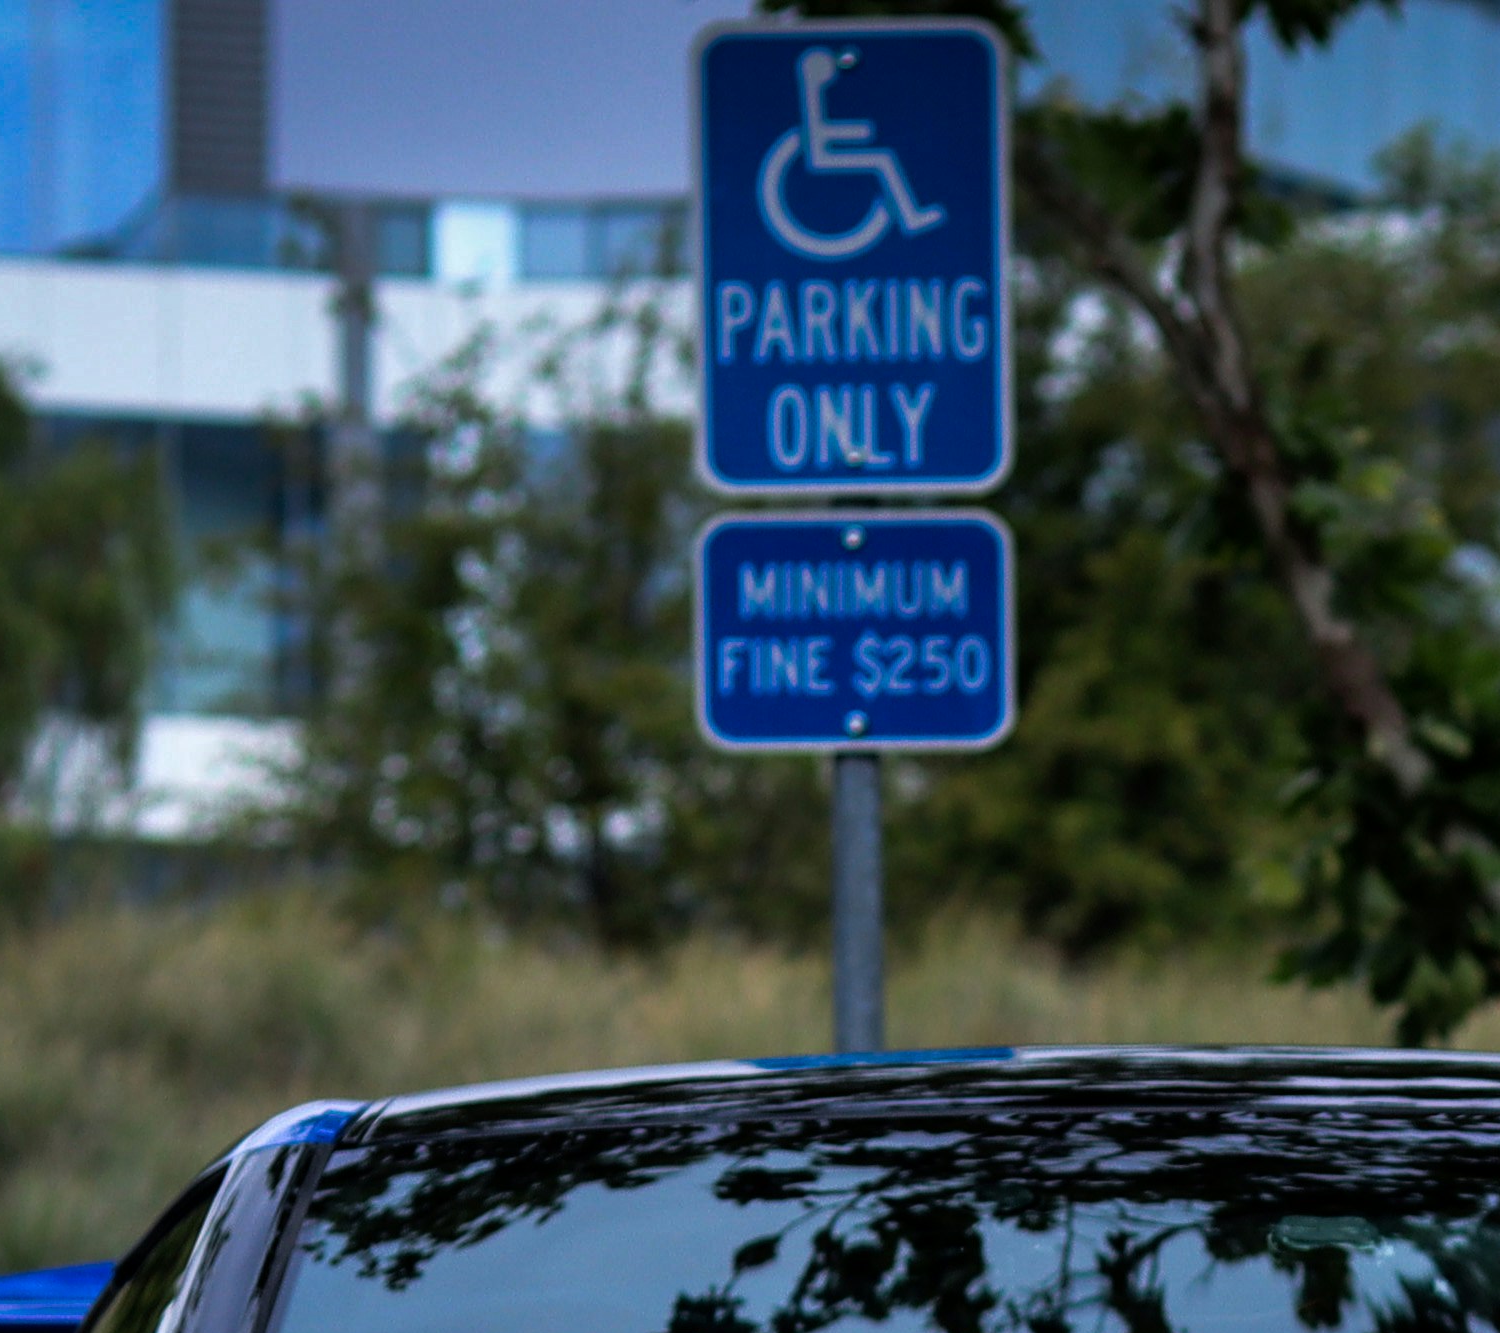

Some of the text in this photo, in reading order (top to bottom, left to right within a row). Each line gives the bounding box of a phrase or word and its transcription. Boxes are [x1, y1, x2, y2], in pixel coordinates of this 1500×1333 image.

[716, 277, 989, 364] PARKING
[767, 382, 936, 471] ONLY
[738, 561, 970, 620] MINIMUM
[719, 632, 989, 697] FINE $250
